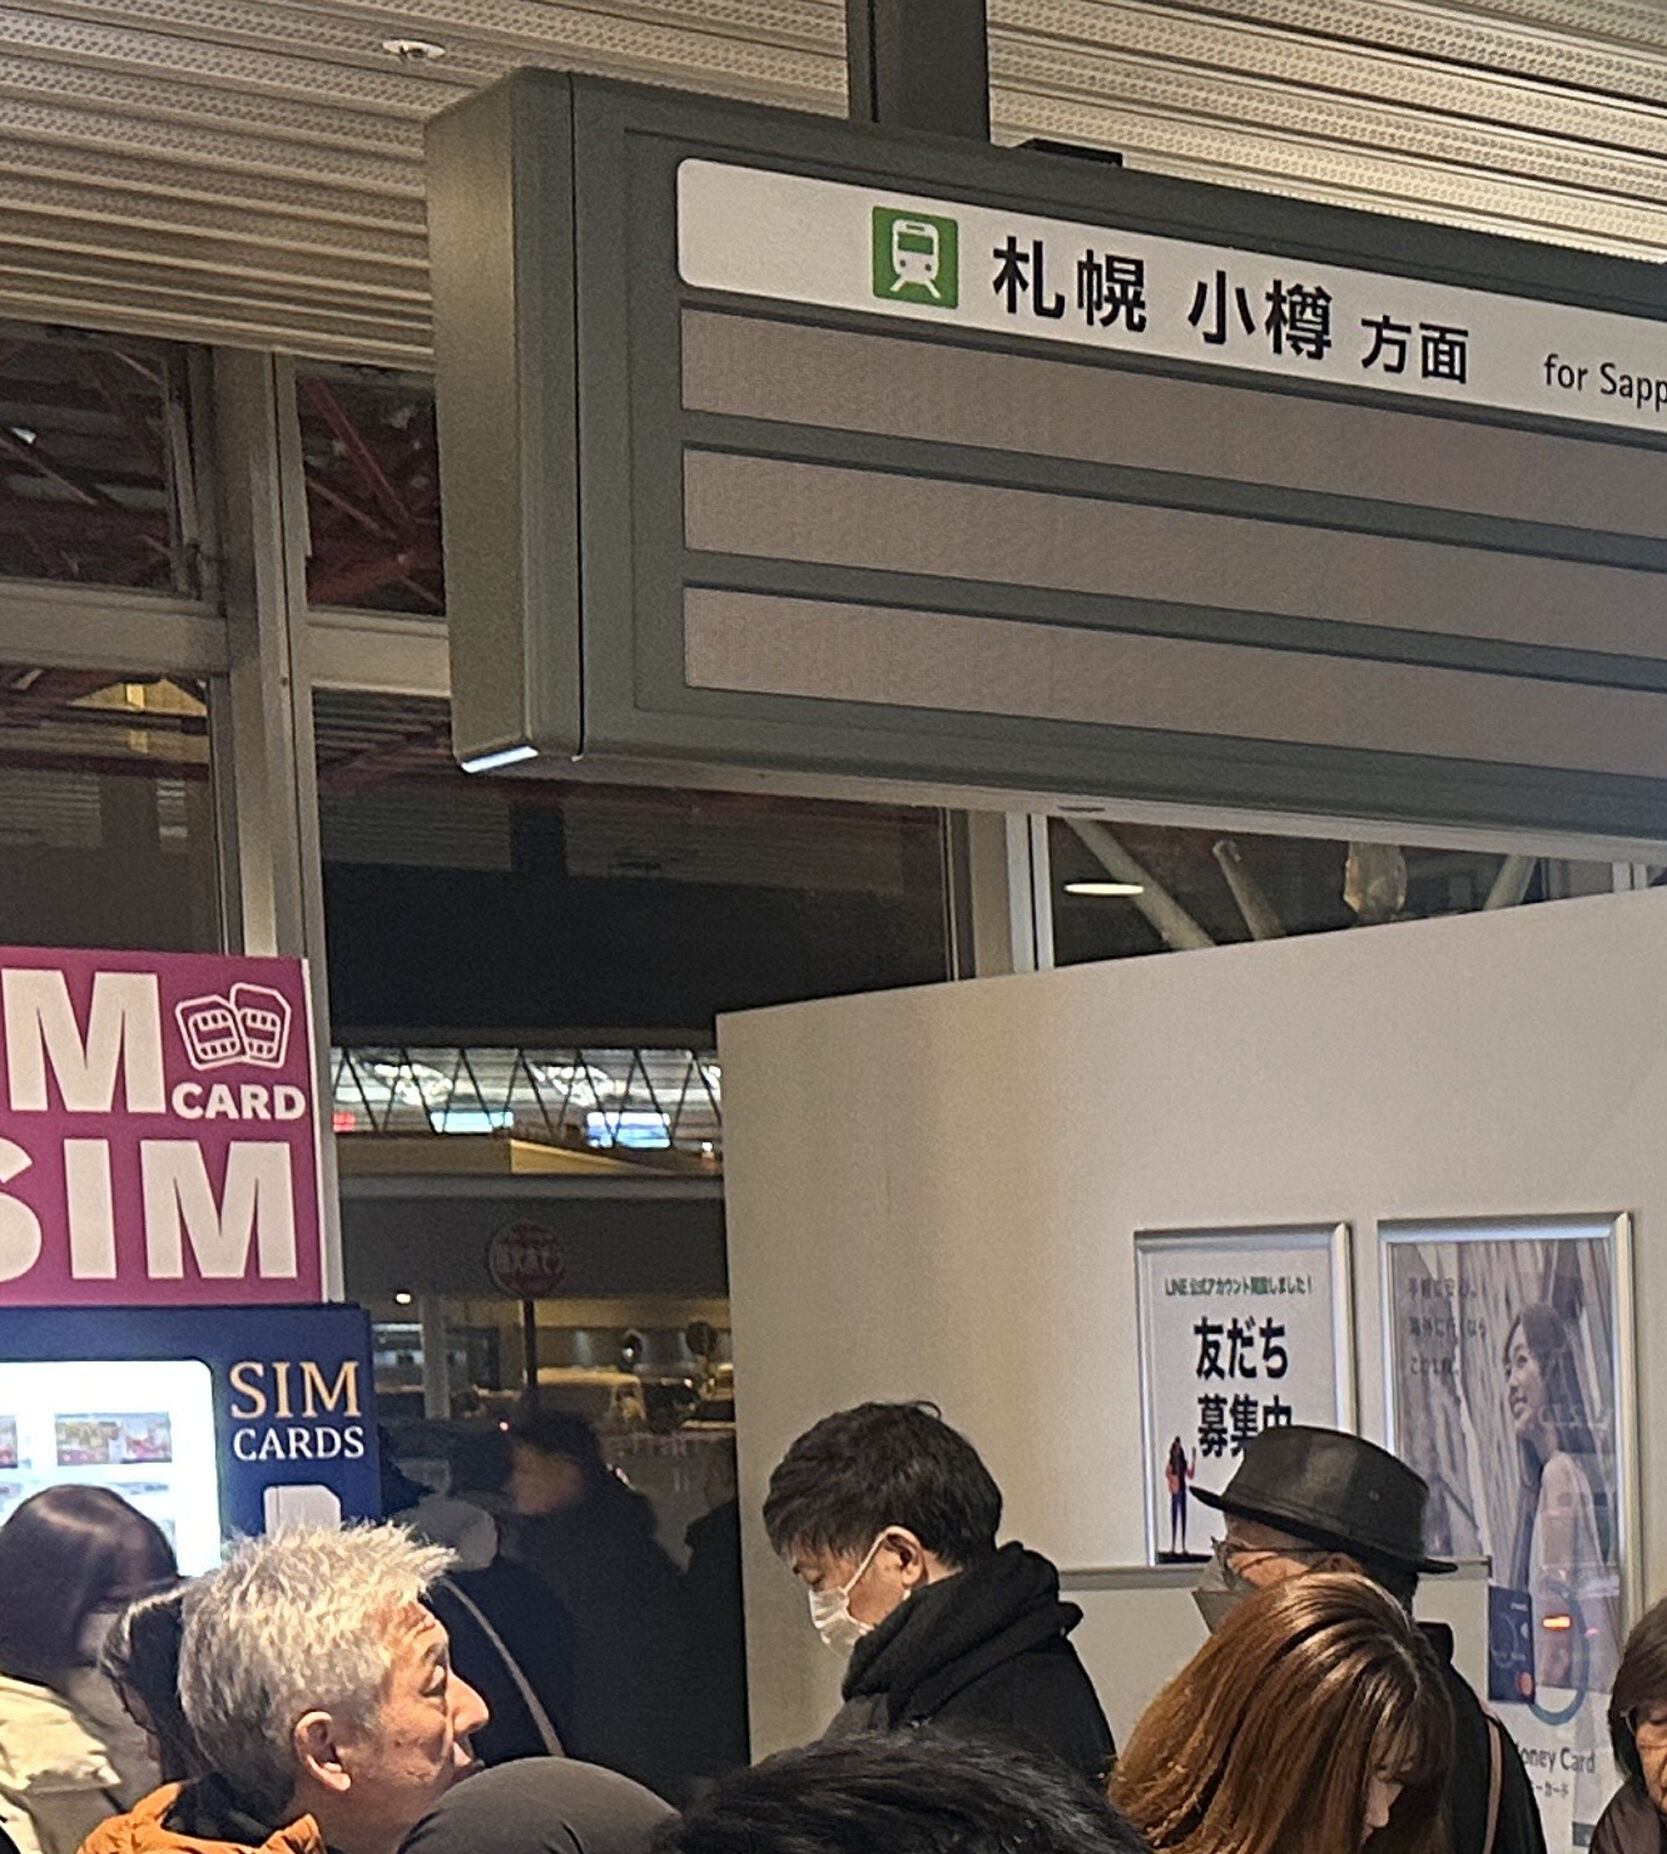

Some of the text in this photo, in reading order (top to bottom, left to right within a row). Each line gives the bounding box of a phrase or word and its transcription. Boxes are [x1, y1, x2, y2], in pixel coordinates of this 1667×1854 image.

[992, 236, 1469, 384] 札幌 小樽 方面
[1544, 353, 1588, 392] for
[172, 1083, 306, 1121] CARD
[1193, 1315, 1289, 1381] 友だち
[229, 1360, 362, 1420] SIM
[233, 1426, 365, 1461] CARDS
[1516, 1746, 1596, 1774] oney Card
